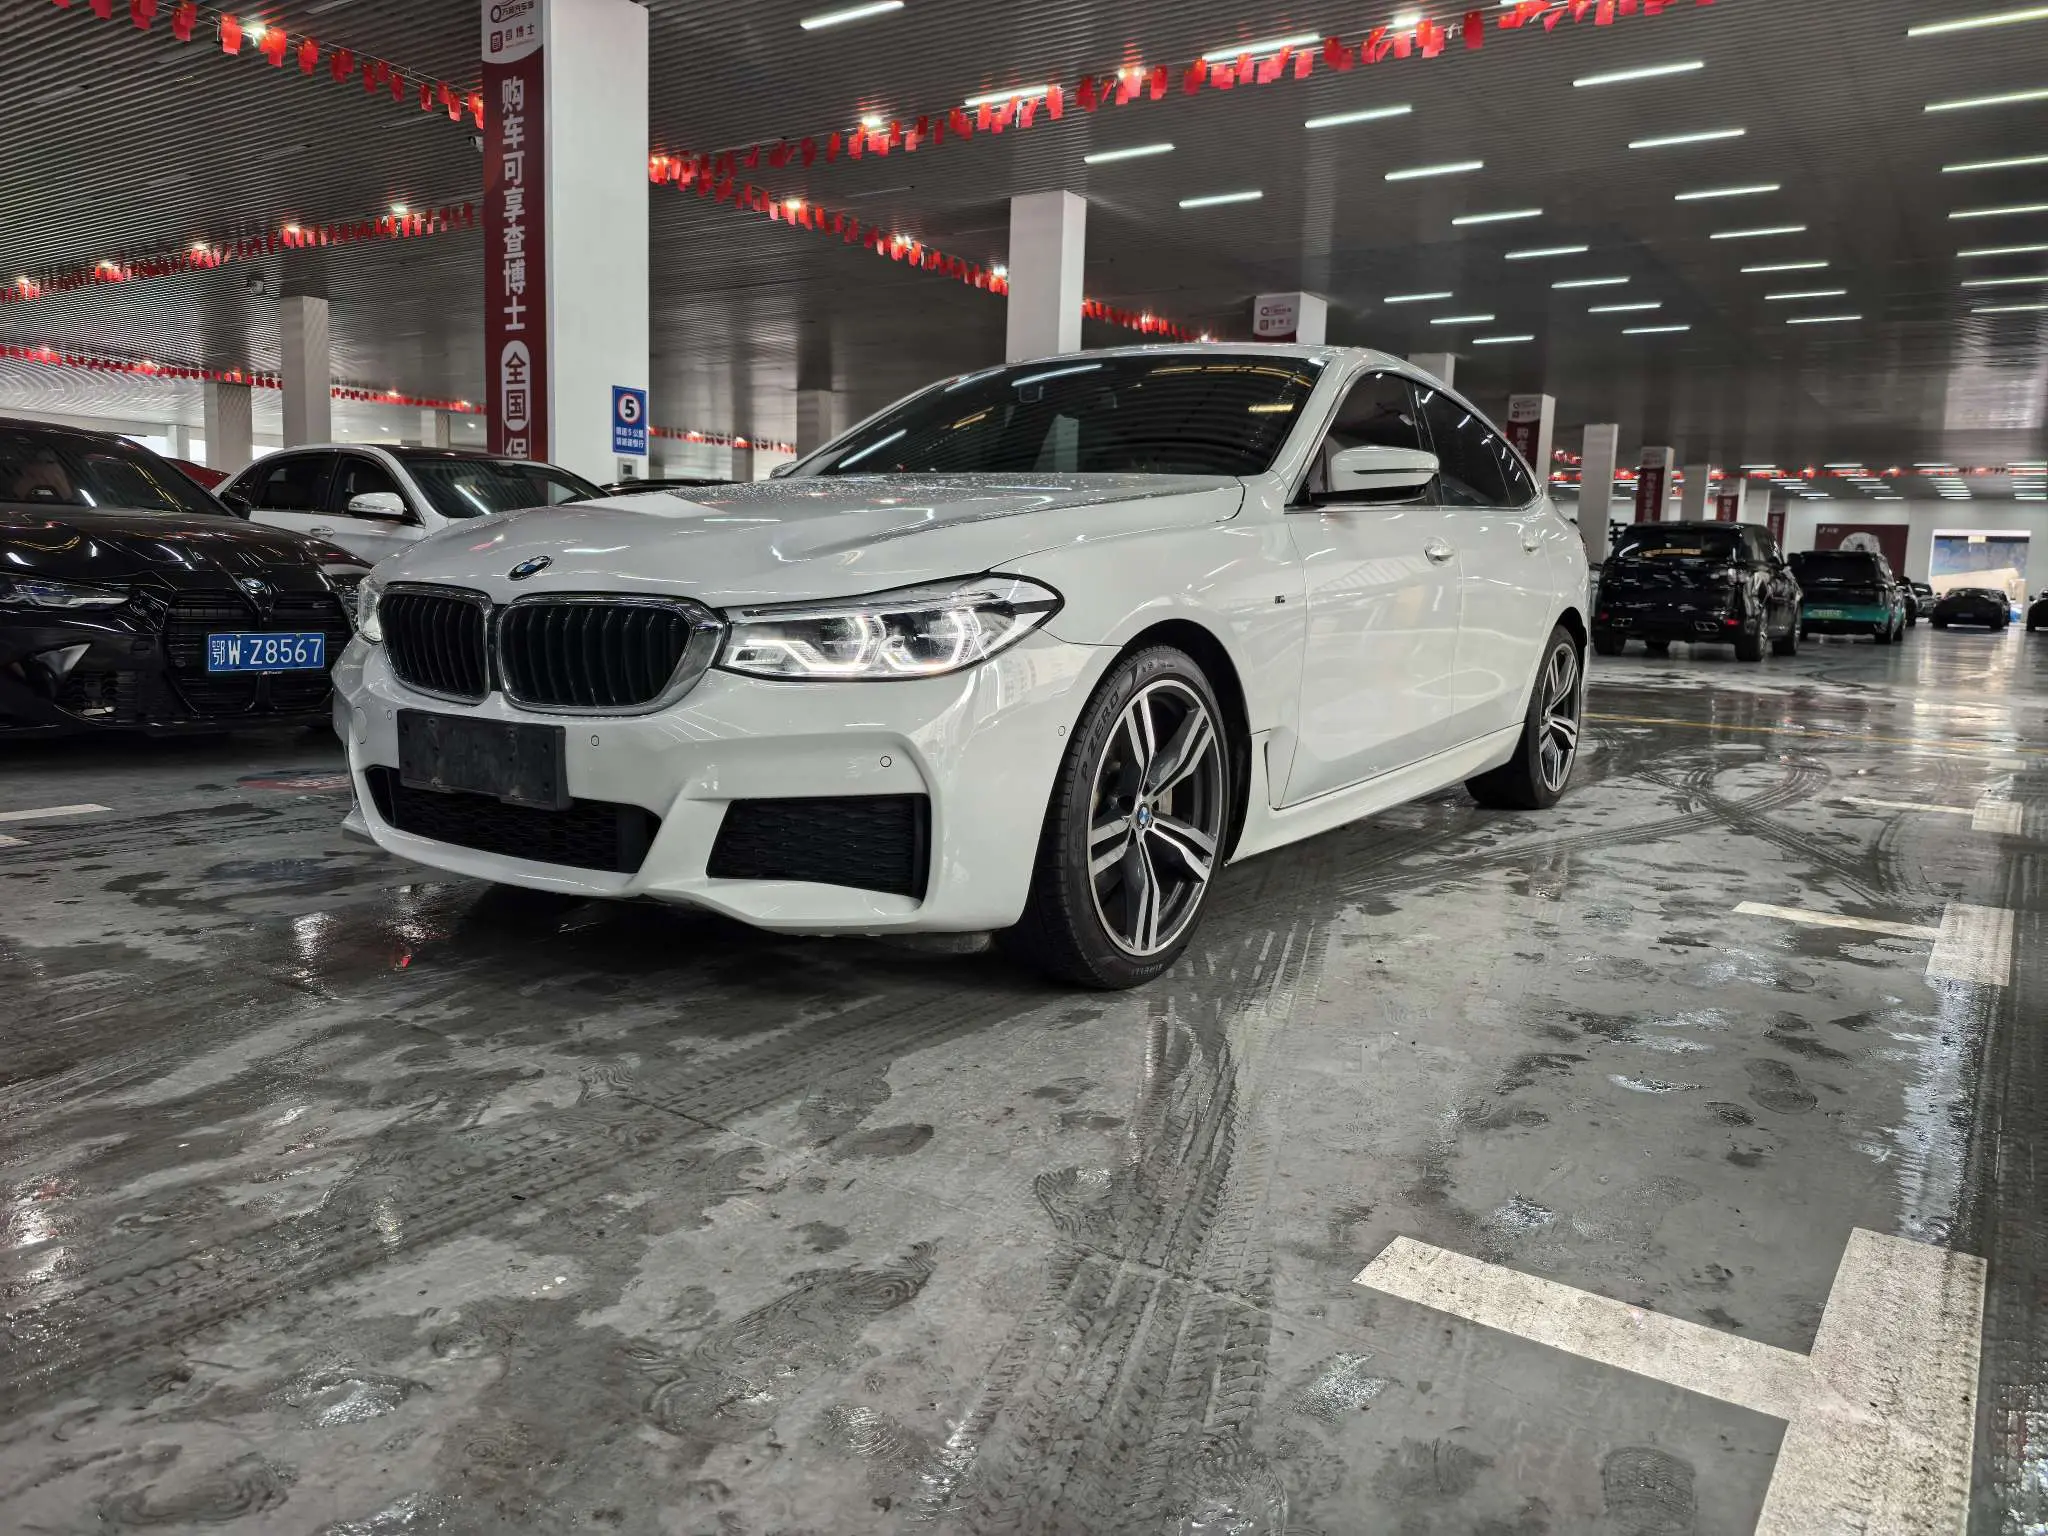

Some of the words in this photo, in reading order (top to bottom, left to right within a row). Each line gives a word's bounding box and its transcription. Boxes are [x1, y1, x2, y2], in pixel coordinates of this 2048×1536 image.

[502, 75, 527, 331] 购车可享查博士
[624, 398, 636, 418] 5
